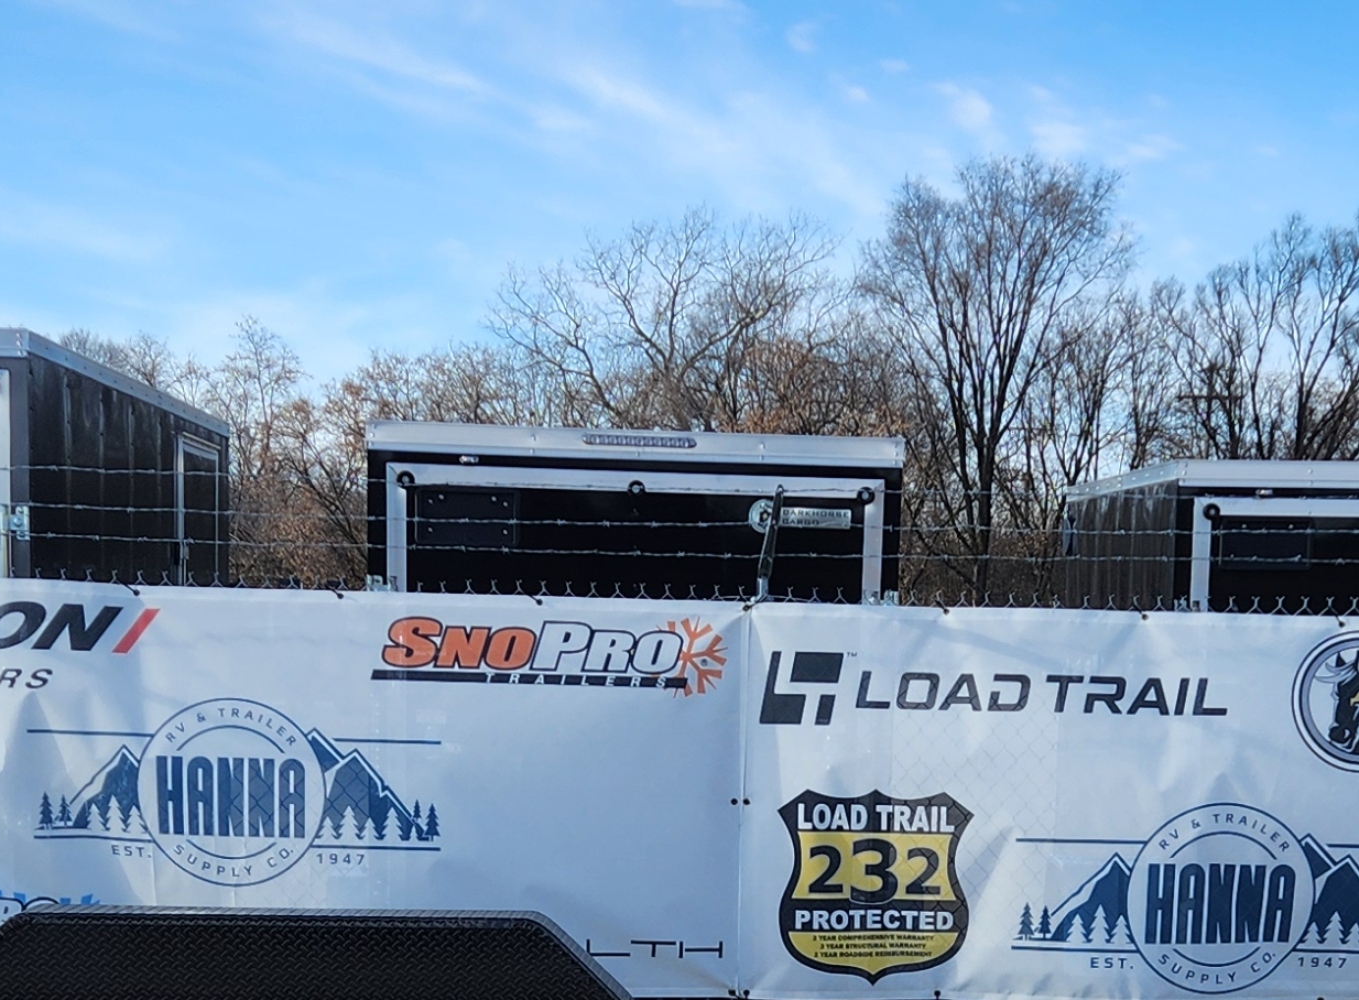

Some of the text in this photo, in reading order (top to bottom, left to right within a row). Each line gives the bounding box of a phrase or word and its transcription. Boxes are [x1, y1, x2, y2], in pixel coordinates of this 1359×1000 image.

[485, 673, 667, 689] TRAILERS
[855, 670, 1032, 712] LOAD
[1046, 674, 1229, 718] TRAIL
[165, 706, 298, 747] RV & TRAILER
[156, 755, 306, 839] HANNA
[796, 802, 955, 833] LOAD TRAIL
[1158, 812, 1290, 853] RV & TRAILER
[111, 844, 152, 859] EST.
[172, 843, 295, 878] SUPPLY CO.
[316, 853, 366, 865] 1947
[807, 837, 941, 904] 232
[794, 909, 954, 932] PROTECTED
[1146, 863, 1296, 945] HANNA
[1089, 957, 1134, 969] EST.
[1158, 951, 1277, 985] SUPPLY CO.
[1297, 956, 1347, 969] 1947
